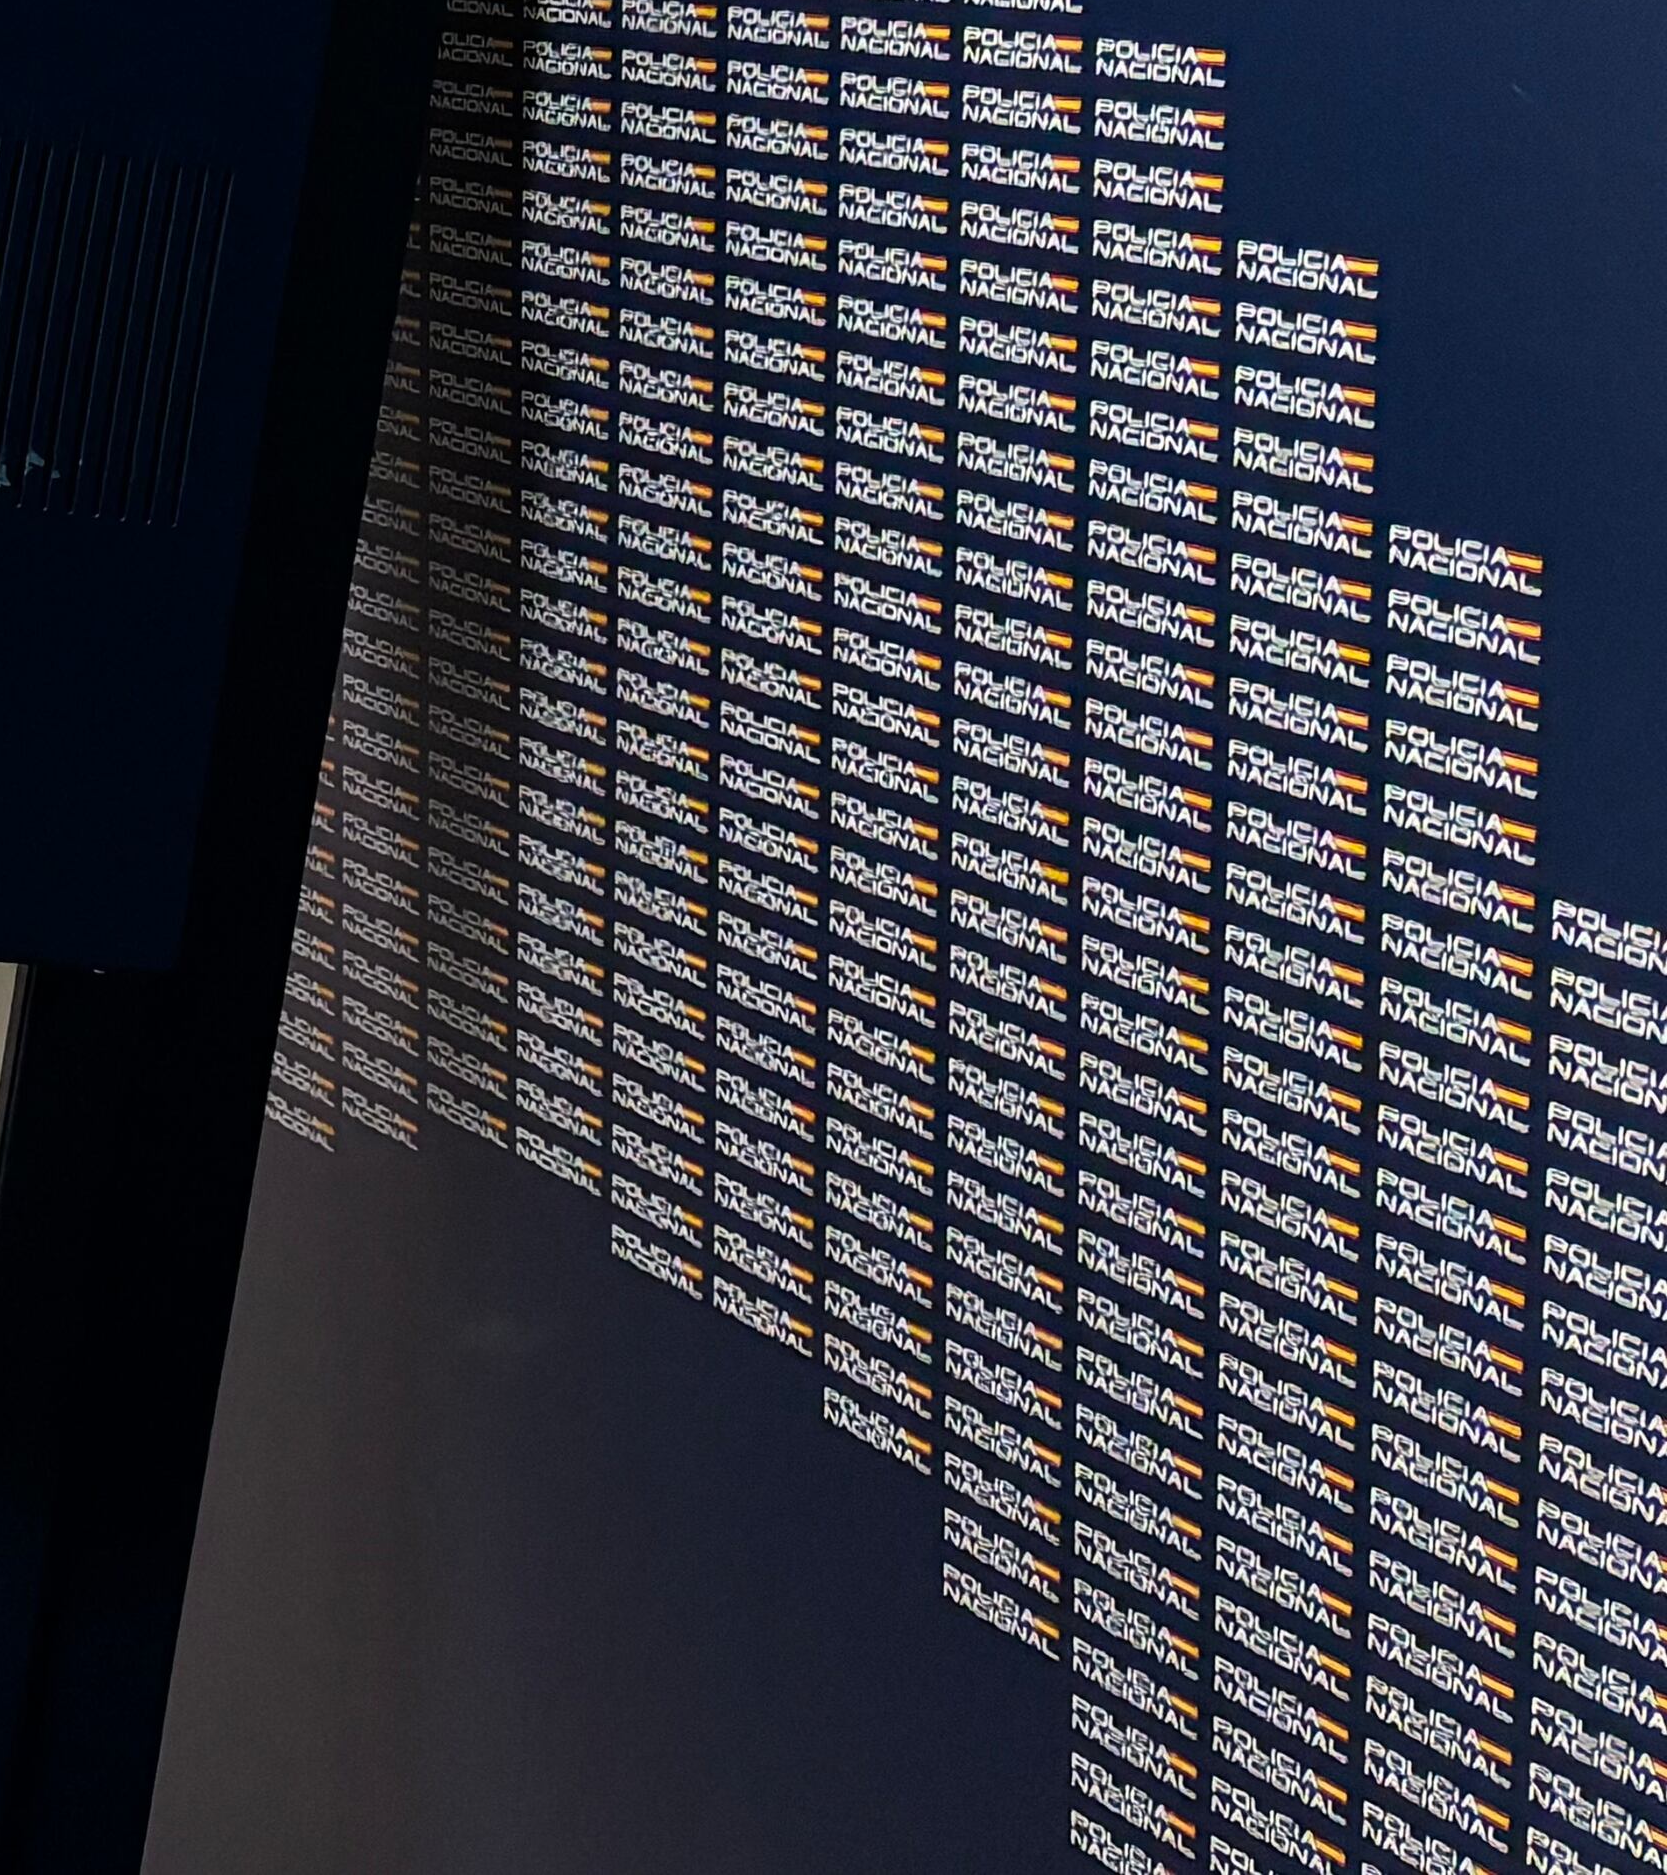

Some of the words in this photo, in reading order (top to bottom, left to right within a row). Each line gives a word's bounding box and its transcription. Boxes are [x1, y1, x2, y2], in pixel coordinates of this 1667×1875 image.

[1096, 57, 1225, 87] NACIONAL
[962, 102, 1081, 134] NACIONAL
[726, 239, 826, 271] NACIONAL
[838, 257, 946, 291] NACIONAL
[1236, 259, 1378, 299] NACIONAL
[959, 335, 1076, 373] NACIONAL
[724, 399, 824, 436] NACIONAL
[1090, 419, 1218, 462] NACIONAL
[1231, 573, 1371, 623] NACIONAL
[1389, 544, 1542, 596] NACIONAL
[722, 611, 822, 655] NACIONAL
[834, 590, 941, 634] NACIONAL
[955, 620, 1072, 670] NACIONAL
[720, 718, 820, 764] NACIONAL
[833, 700, 939, 747] NACIONAL
[1085, 717, 1212, 771] NACIONAL
[1385, 740, 1537, 799] NACIONAL
[952, 793, 1069, 847] NACIONAL
[1227, 821, 1366, 880] NACIONAL
[829, 917, 936, 971] NACIONAL
[1082, 894, 1209, 954] NACIONAL
[1553, 899, 1667, 954] POLICI
[717, 981, 815, 1035] NACIONAL
[1082, 953, 1209, 1015] NACIONAL
[949, 1018, 1065, 1080] NACIONAL
[1224, 1006, 1362, 1072] NACIONAL
[1380, 997, 1530, 1066] NACIONAL
[827, 1080, 934, 1140] NACIONAL
[1223, 1066, 1361, 1135] NACIONAL
[1376, 1189, 1526, 1265] NACIONAL
[947, 1245, 1062, 1314] NACIONAL
[1078, 1246, 1204, 1319] NACIONAL
[1220, 1249, 1357, 1326] NACIONAL
[946, 1300, 1062, 1371] NACIONAL
[1077, 1305, 1203, 1379] NACIONAL
[824, 1402, 931, 1475] NACIONAL
[1373, 1379, 1520, 1463] NACIONAL
[1371, 1443, 1519, 1528] NACIONAL
[944, 1526, 1059, 1603] NACIONAL
[1217, 1493, 1352, 1577] NACIONAL
[1075, 1537, 1198, 1620] NACIONAL
[1073, 1655, 1197, 1740] NACIONAL
[1368, 1632, 1513, 1723] NACIONAL
[1214, 1675, 1348, 1764] NACIONAL
[1366, 1693, 1511, 1789] NACIONAL
